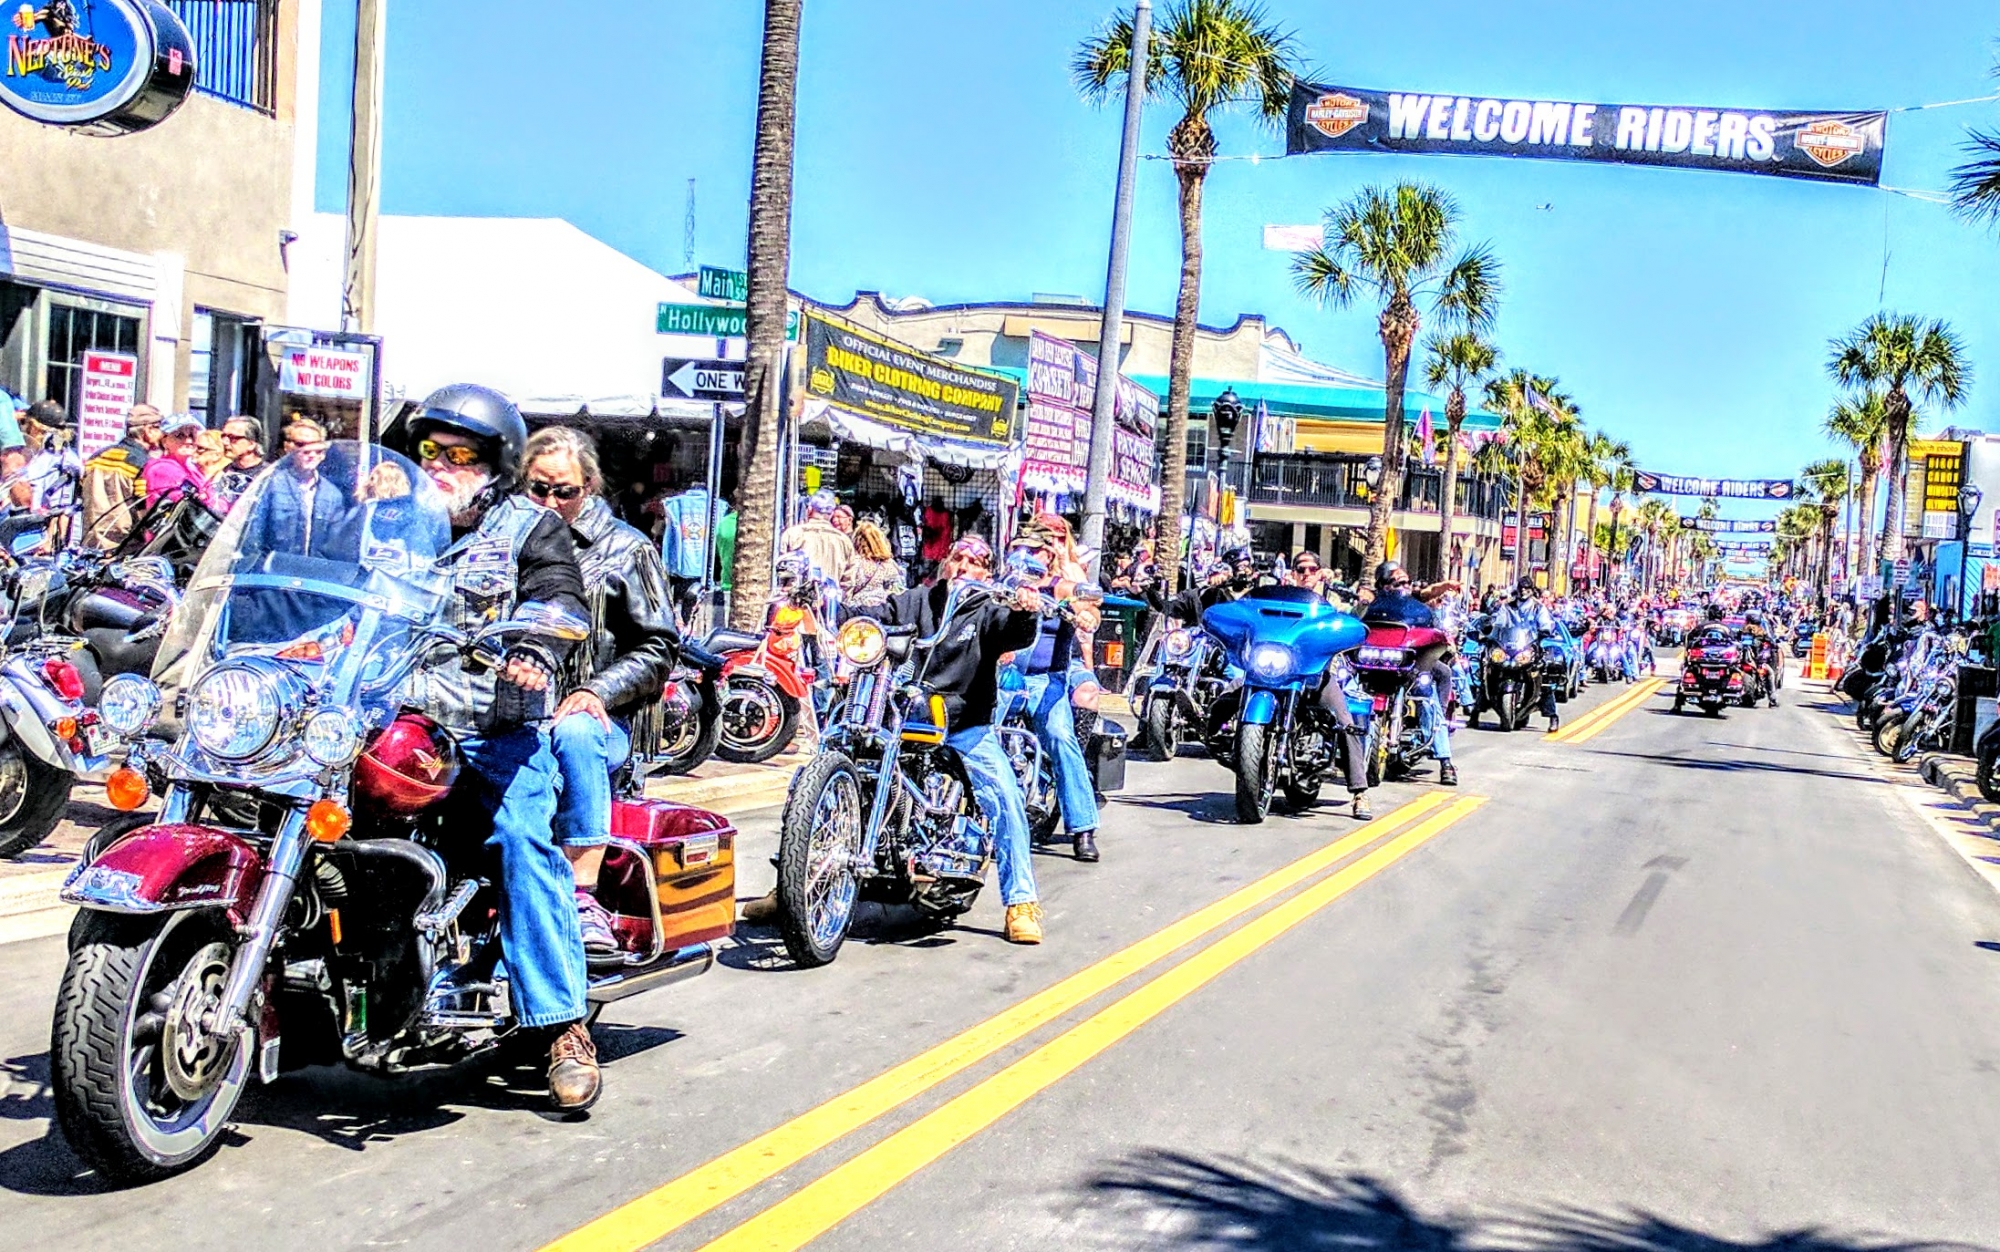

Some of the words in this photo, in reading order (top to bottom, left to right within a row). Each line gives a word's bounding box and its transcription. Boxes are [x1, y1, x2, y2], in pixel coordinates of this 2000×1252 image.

[1388, 94, 1597, 147] WELCOME
[1616, 106, 1777, 162] RIDERS
[701, 269, 734, 299] Main
[660, 304, 667, 314] N
[668, 309, 747, 335] Hollywoo
[292, 353, 306, 367] NO
[309, 354, 360, 373] WEAPONS
[842, 336, 891, 362] OFFICIAL
[893, 354, 926, 374] EVENT
[927, 364, 998, 392] MERCHANDISE
[297, 372, 312, 385] NO
[313, 373, 352, 390] COLORS
[696, 371, 728, 389] ONE
[826, 345, 873, 378] BIKER
[873, 362, 941, 400] CLOTHING
[941, 382, 1003, 413] COMPANY
[1660, 476, 1718, 496] WELCOME
[1722, 480, 1765, 498] RIDERS
